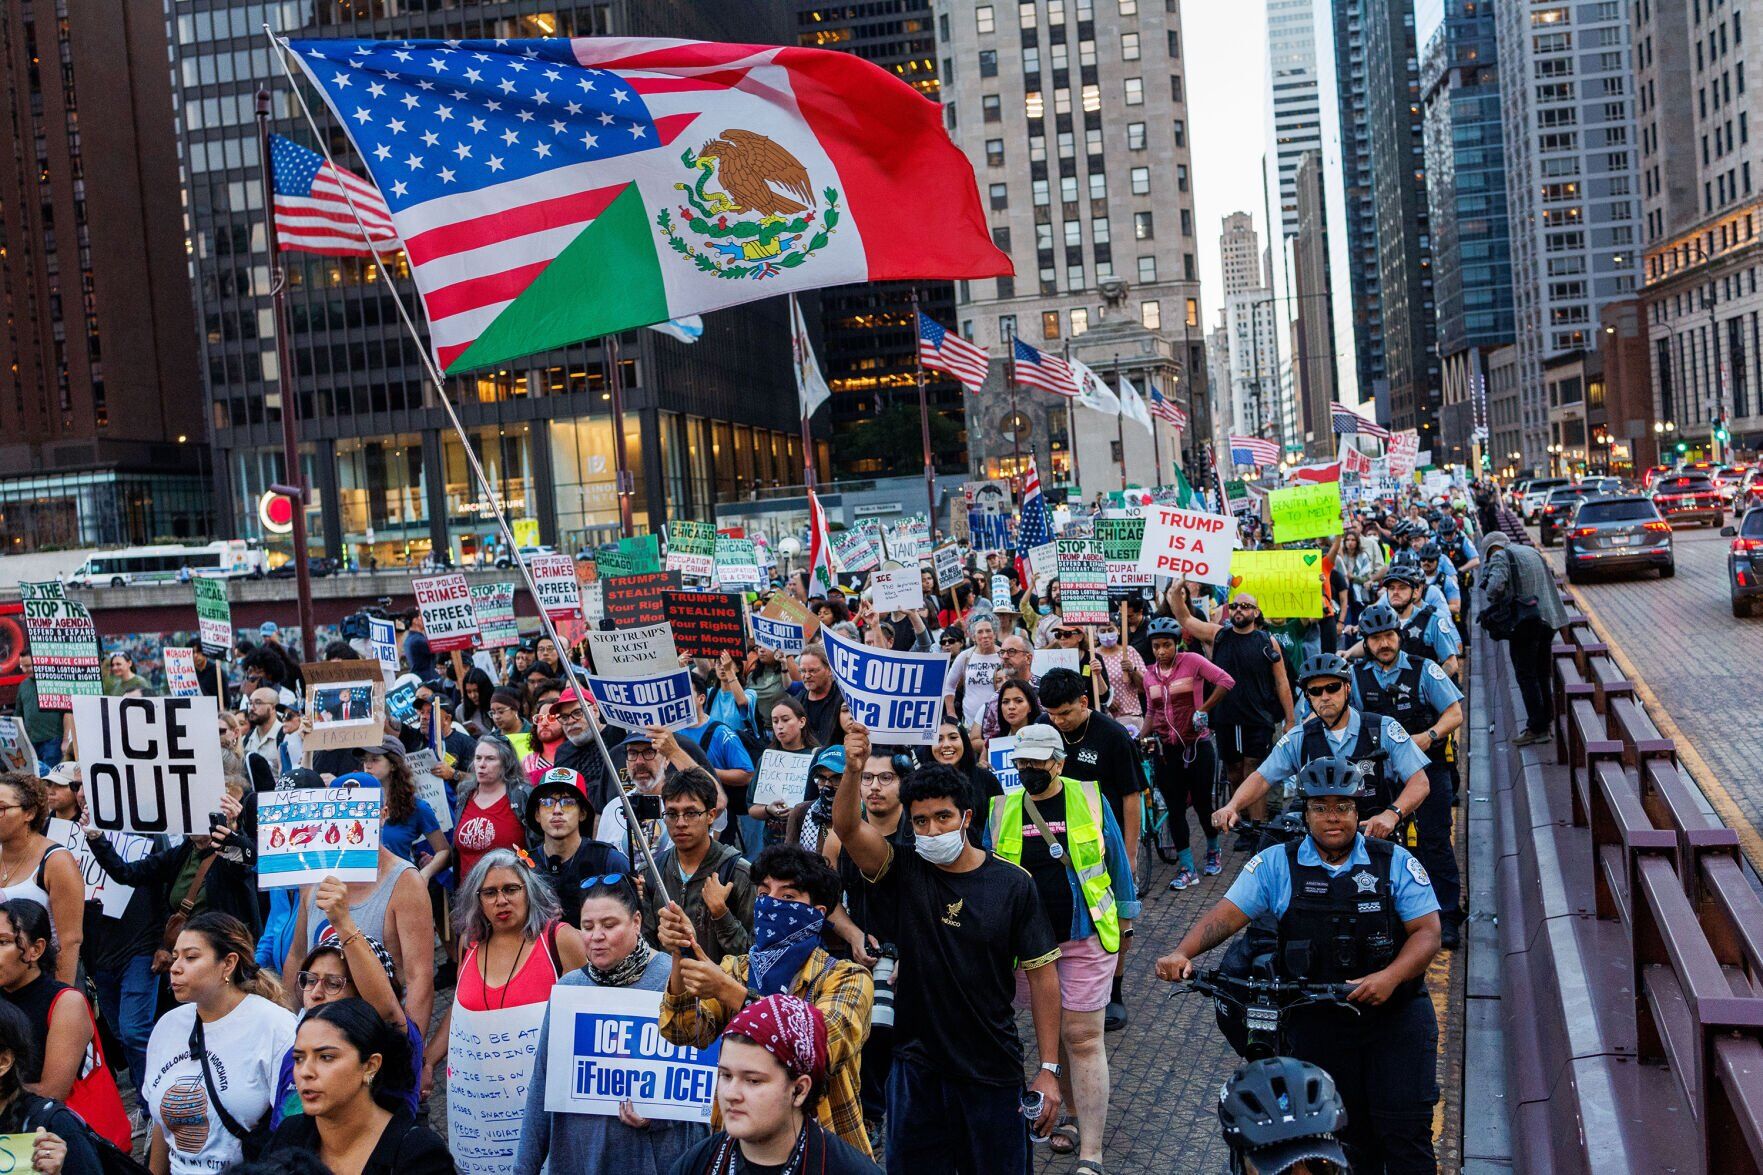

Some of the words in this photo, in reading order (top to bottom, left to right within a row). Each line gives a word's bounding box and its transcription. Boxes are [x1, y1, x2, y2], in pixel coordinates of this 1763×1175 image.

[1389, 434, 1402, 445] NO
[1316, 495, 1335, 506] DAY
[1125, 507, 1141, 517] NO
[1288, 511, 1302, 521] TO
[1307, 506, 1333, 518] MELT
[855, 518, 869, 527] STOP
[895, 517, 914, 526] STOP
[1159, 511, 1224, 534] TRUMP
[671, 527, 715, 540] CHICAGO
[1096, 528, 1144, 541] CHICAG
[832, 534, 847, 547] STOP
[1058, 540, 1086, 553] STOP
[1088, 540, 1103, 554] THE
[1168, 535, 1186, 550] IS
[1190, 539, 1205, 554] A
[669, 543, 713, 556] PALESTINE
[715, 543, 753, 553] CHICAGO
[533, 558, 548, 566] STOP
[551, 557, 571, 565] POLICE
[596, 556, 632, 571] CHICAGO
[668, 555, 711, 565] OCCUPATION
[716, 557, 756, 565] PALESTINE
[1156, 555, 1209, 576] PEDO
[534, 565, 574, 579] CRIMES
[685, 565, 710, 573] CRIME!
[415, 582, 434, 590] STOP
[436, 576, 463, 587] POLICE
[609, 573, 669, 586] TRUMP'S
[875, 573, 892, 583] ICE
[1110, 574, 1117, 583] A
[1121, 574, 1152, 583] CRIME!
[38, 583, 63, 598] THE
[417, 585, 468, 604] CRIMES
[471, 587, 495, 598] STOP
[497, 584, 513, 593] THE
[544, 582, 570, 594] FREE
[564, 595, 579, 603] ALL
[669, 593, 729, 604] TRUMP'S
[26, 601, 59, 618] STOP
[62, 601, 89, 618] THE
[431, 605, 465, 621] FREE
[607, 604, 635, 613] Your
[669, 606, 736, 618] STEALING
[28, 618, 53, 628] TRUMP
[425, 622, 453, 634] THEM
[457, 618, 477, 630] ALL
[669, 619, 696, 629] Your
[699, 620, 740, 631] Rights
[758, 616, 772, 634] ICE
[773, 620, 795, 638] OUT!
[593, 632, 621, 644] STOP
[621, 626, 666, 642] TRUMP'S
[701, 633, 742, 646] Money
[612, 641, 649, 653] RACIST
[784, 640, 802, 650] ICE!
[165, 649, 192, 659] NOBODY
[380, 645, 396, 662] ICE!
[611, 652, 657, 664] AGENDA!
[33, 657, 48, 665] STOP
[51, 657, 71, 665] POLICE
[73, 657, 99, 665] CRIMES
[33, 665, 56, 673] DEFEND
[166, 666, 195, 675] ILLEGAL
[832, 643, 861, 685] ICE
[864, 659, 925, 694] OUT!
[169, 681, 199, 689] STOLEN
[38, 694, 61, 702] DEFEND
[602, 683, 631, 705] ICE
[633, 679, 676, 705] OUT!
[39, 701, 71, 709] ACADEMIC
[657, 699, 691, 726] ICE!
[887, 700, 936, 729] ICE!
[99, 697, 195, 761] ICE
[762, 751, 785, 768] FUCK
[790, 756, 811, 769] ICE
[760, 769, 782, 782] FUCK
[757, 781, 776, 795] FUCK
[89, 763, 197, 834] OUT
[274, 790, 317, 805] MELT
[324, 788, 352, 801] ICE!
[488, 1032, 511, 1044] BE
[518, 1028, 539, 1039] AT
[593, 1019, 634, 1055] ICE
[466, 1044, 537, 1060] READING,
[152, 1075, 162, 1088] ICE
[209, 1054, 229, 1092] HORCHATA
[462, 1071, 480, 1082] ICE
[485, 1074, 505, 1082] IS
[510, 1069, 524, 1079] ON
[576, 1060, 657, 1099] ¡Fuera
[663, 1066, 714, 1104] ICE!
[189, 1158, 203, 1168] MY
[472, 1163, 496, 1173] DUE
